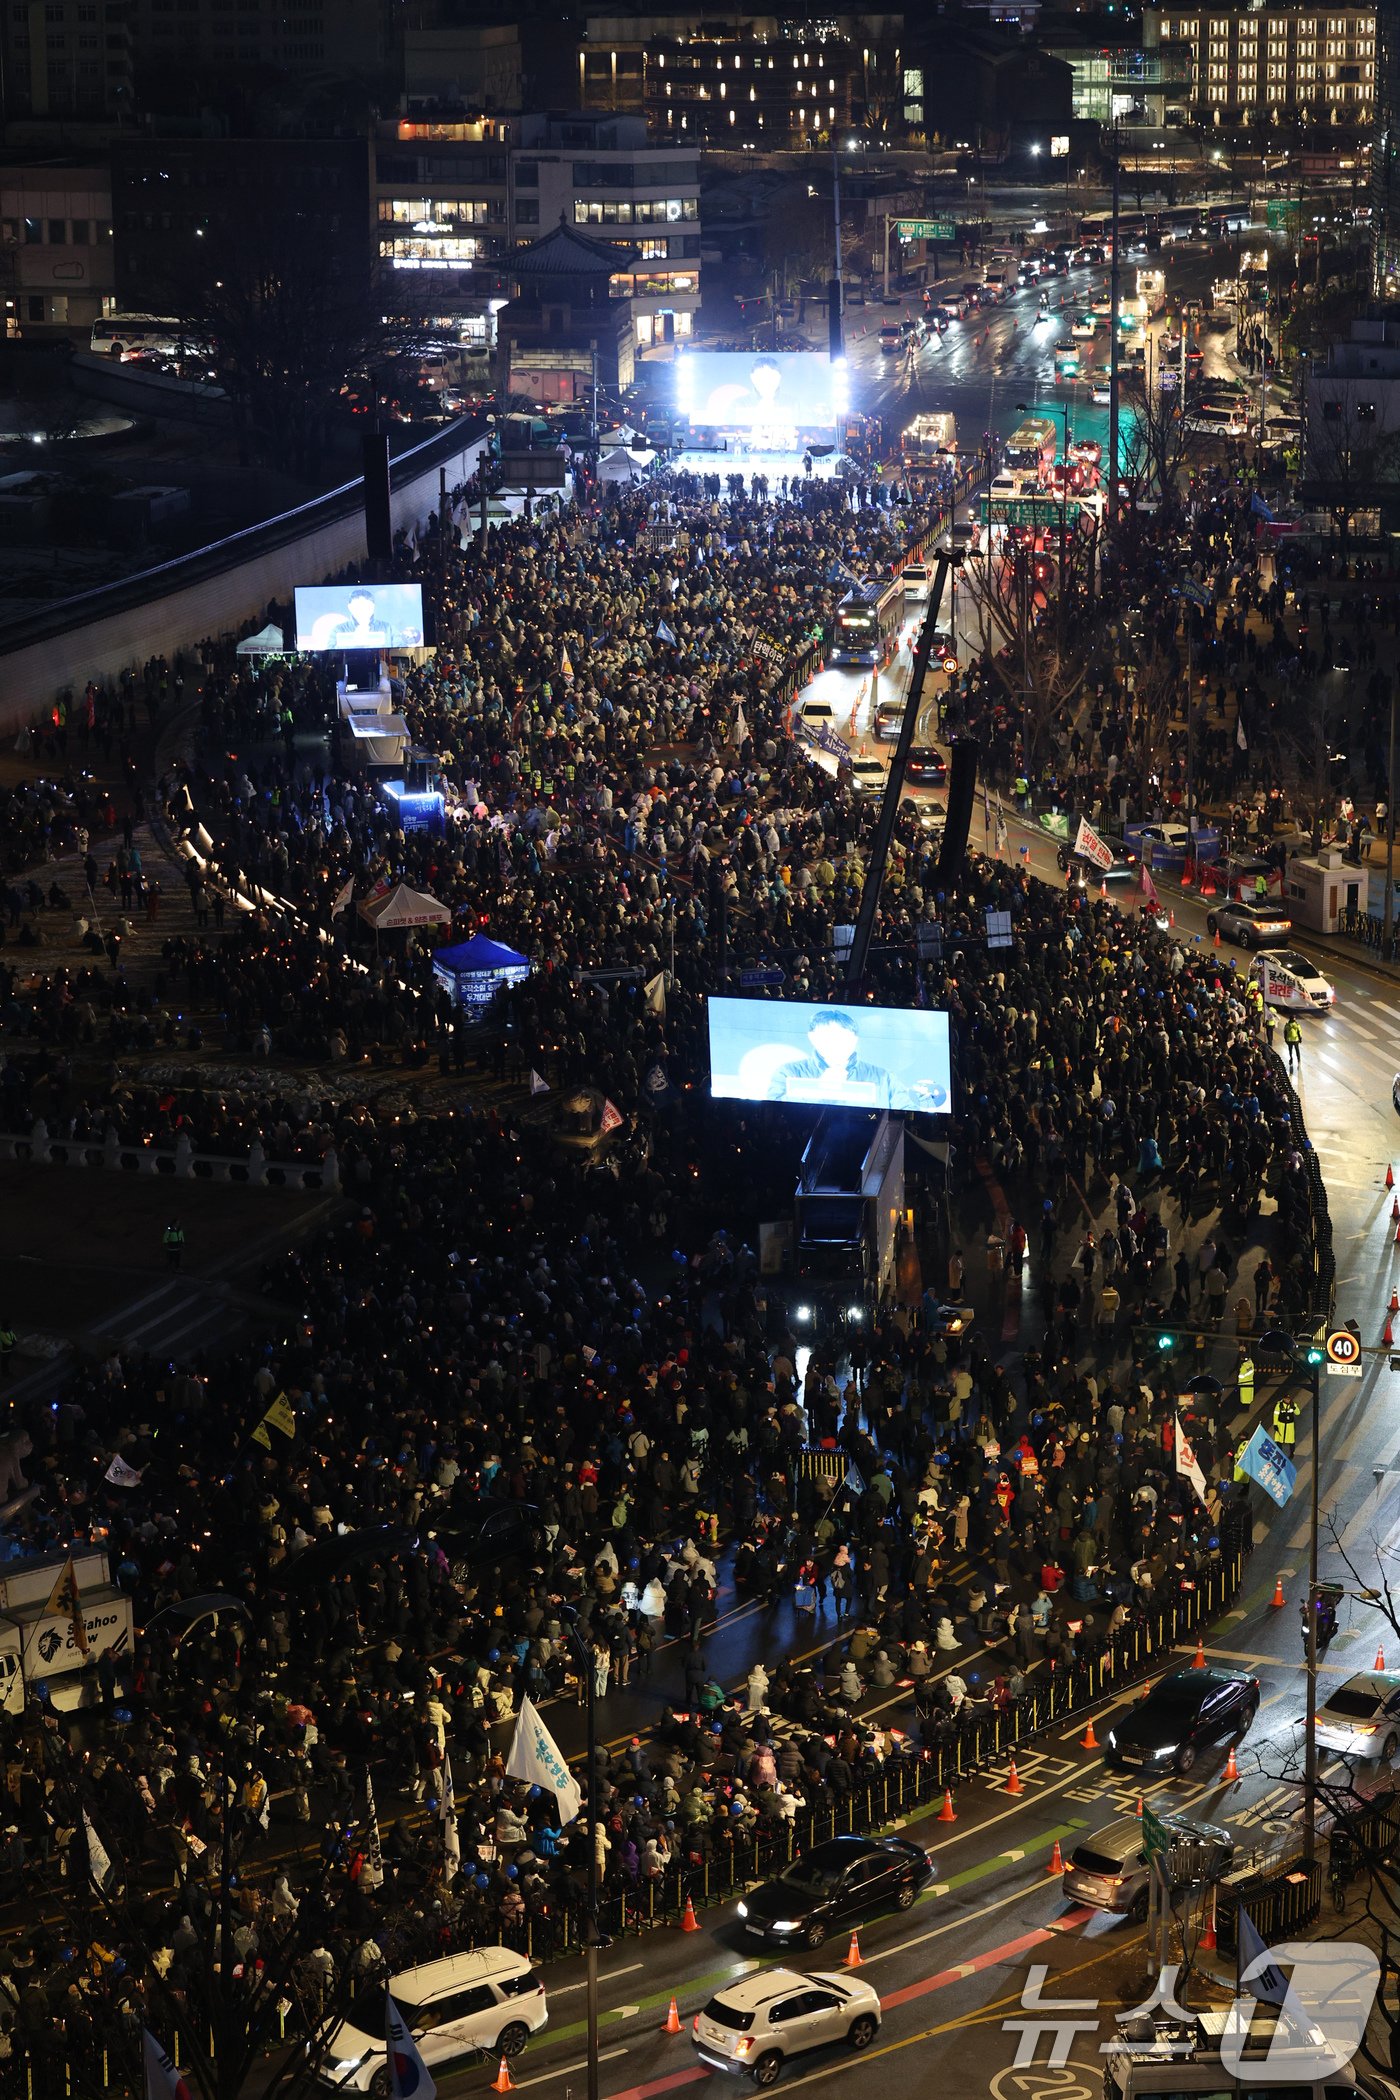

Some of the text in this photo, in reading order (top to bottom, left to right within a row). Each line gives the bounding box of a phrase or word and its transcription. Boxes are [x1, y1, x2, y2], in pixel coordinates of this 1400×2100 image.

[1334, 1340, 1352, 1356] 40
[1330, 1364, 1359, 1375] 도심부
[67, 1615, 118, 1636] Sjahoo
